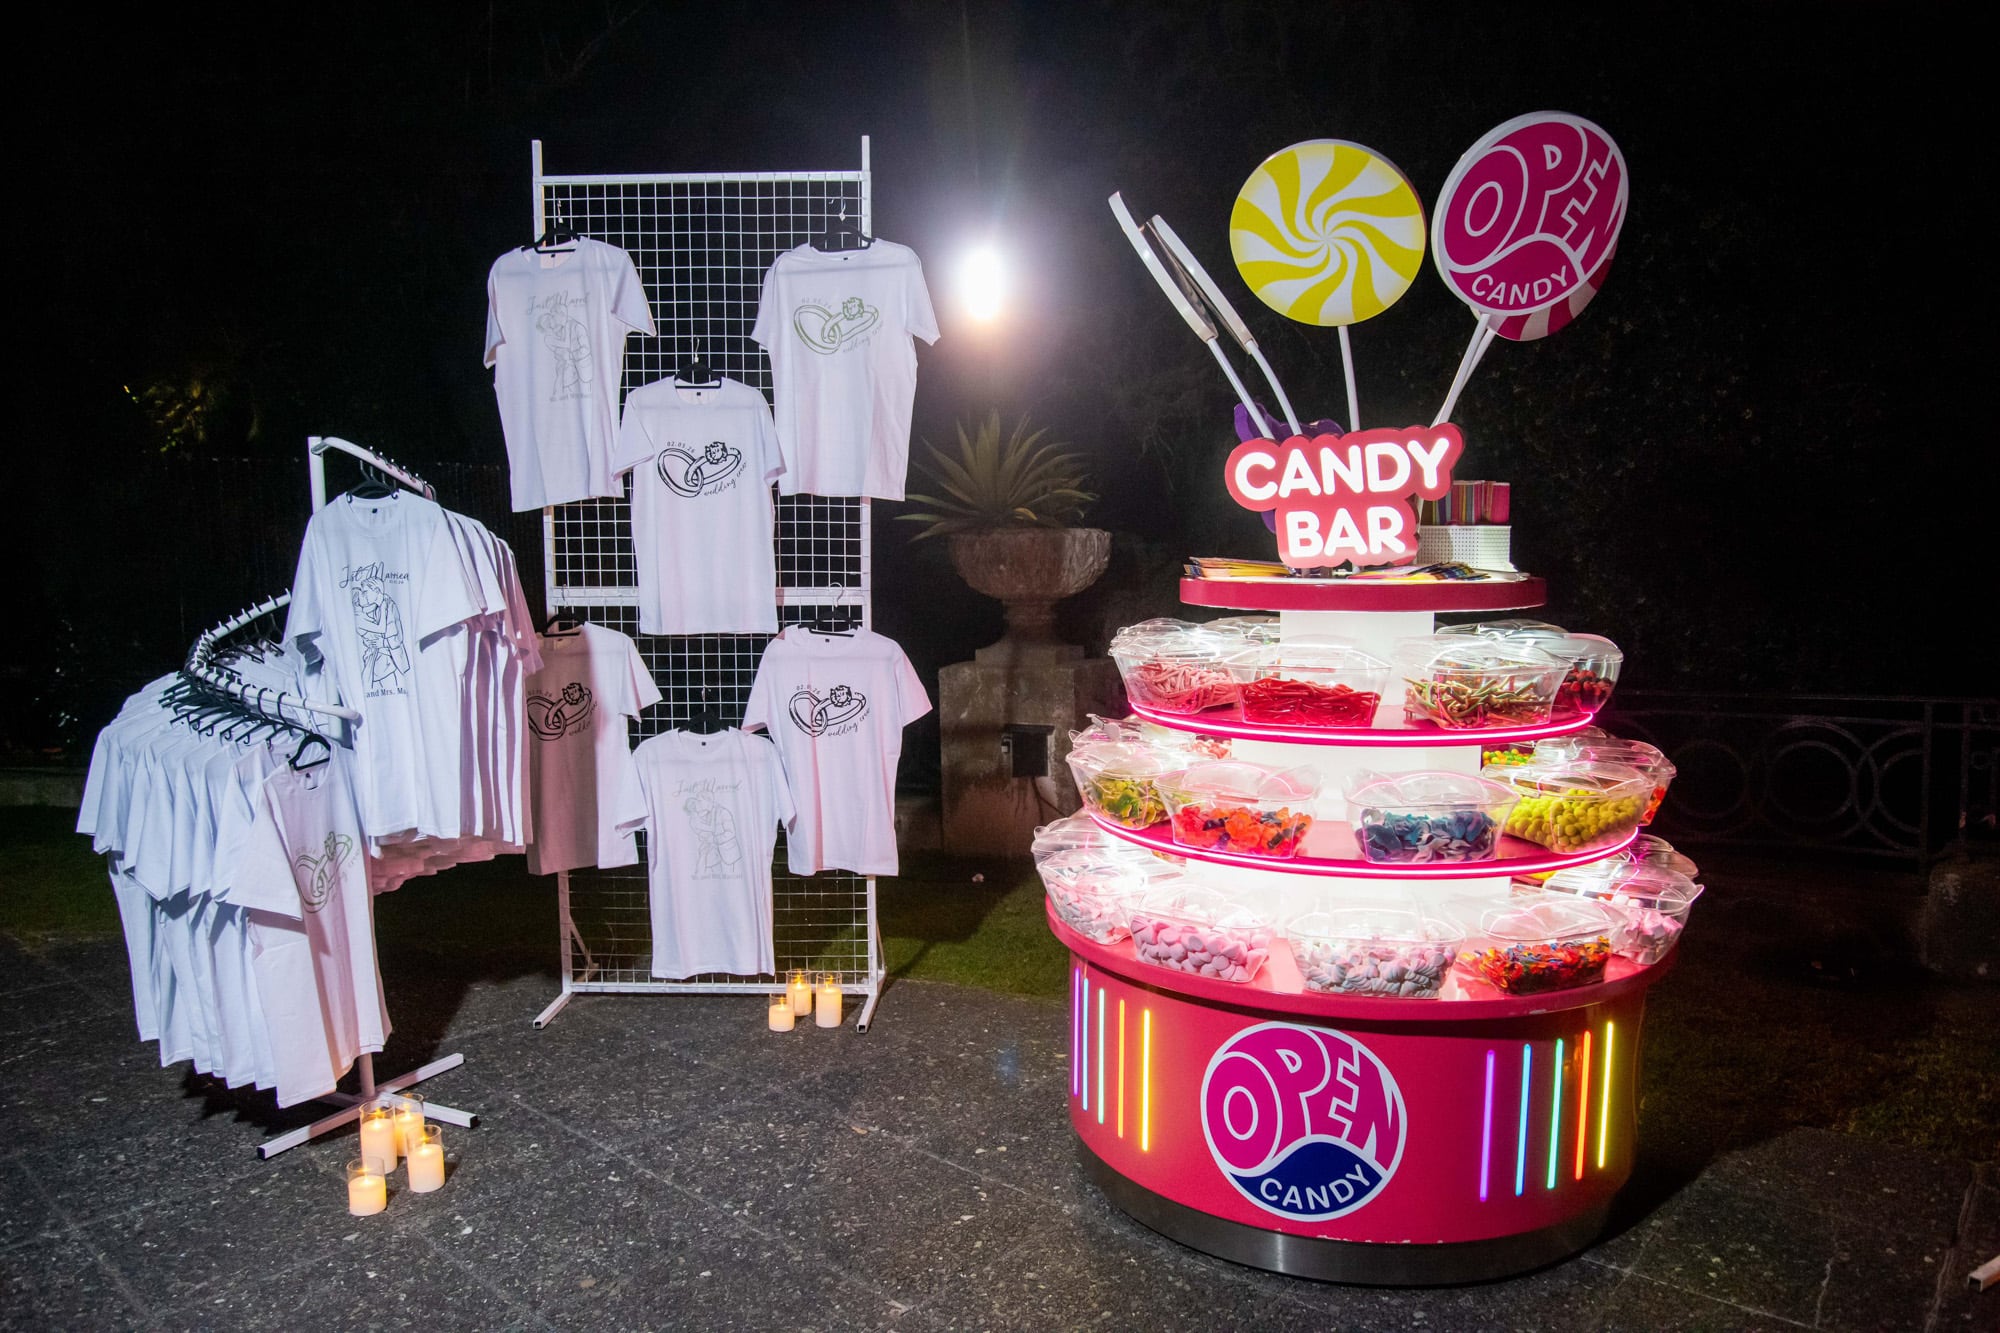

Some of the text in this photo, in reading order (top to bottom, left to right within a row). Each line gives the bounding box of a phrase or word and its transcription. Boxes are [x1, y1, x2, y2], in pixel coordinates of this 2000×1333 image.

[1443, 119, 1628, 274] OPEN
[1471, 264, 1569, 307] CANDY
[703, 462, 748, 497] wedding crew
[1234, 437, 1451, 501] CANDY
[1285, 505, 1407, 559] BAR
[380, 688, 395, 697] Mrs.
[827, 707, 871, 737] wedding crew
[1206, 1026, 1401, 1173] OPEN
[1260, 1164, 1371, 1210] CANDY
